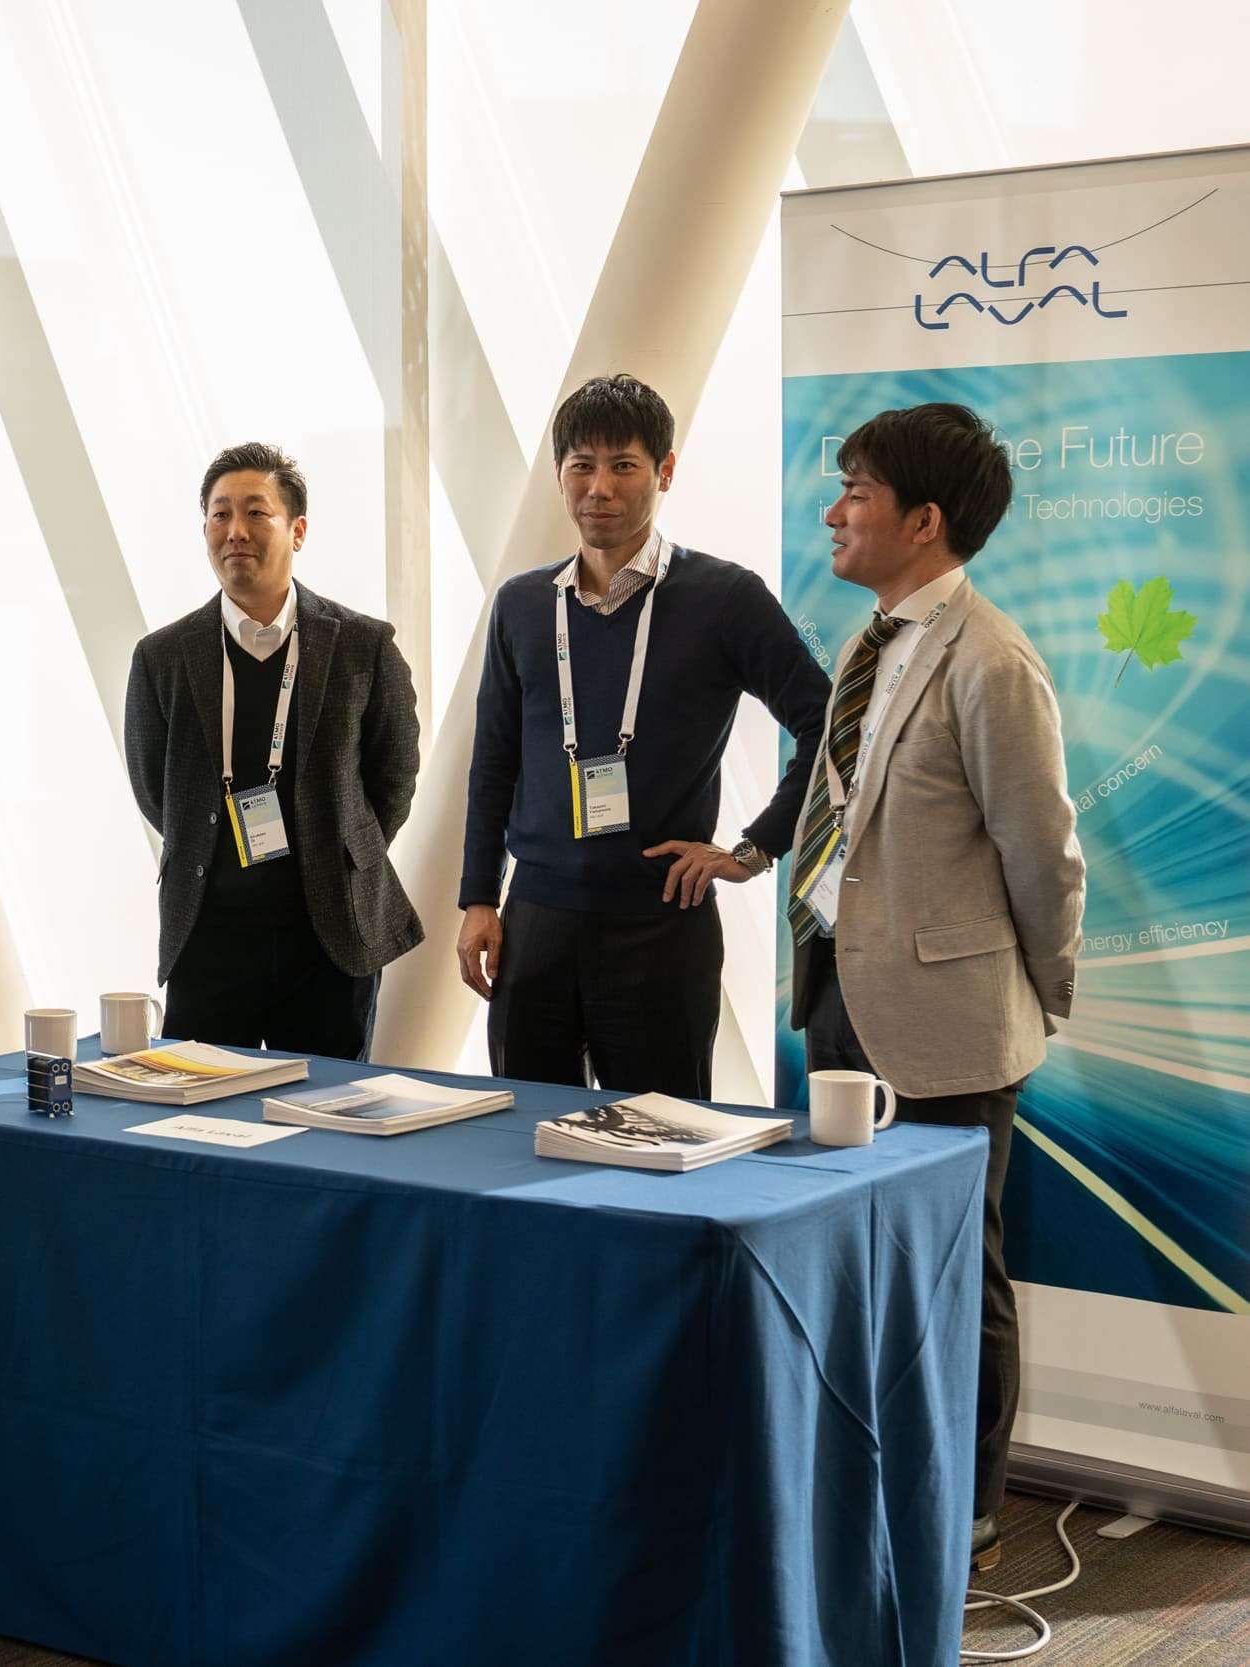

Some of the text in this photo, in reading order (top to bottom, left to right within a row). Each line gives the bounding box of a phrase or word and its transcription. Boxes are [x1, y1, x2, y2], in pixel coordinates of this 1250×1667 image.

[929, 245, 1099, 287] ALFA
[915, 281, 1128, 330] LAVAL
[991, 426, 1206, 471] he Future
[1022, 490, 1204, 524] Technologies
[797, 614, 831, 667] design
[1098, 744, 1163, 798] concern
[1081, 920, 1229, 953] nergy efficiency
[1139, 1402, 1224, 1423] www.alfalaval.com
